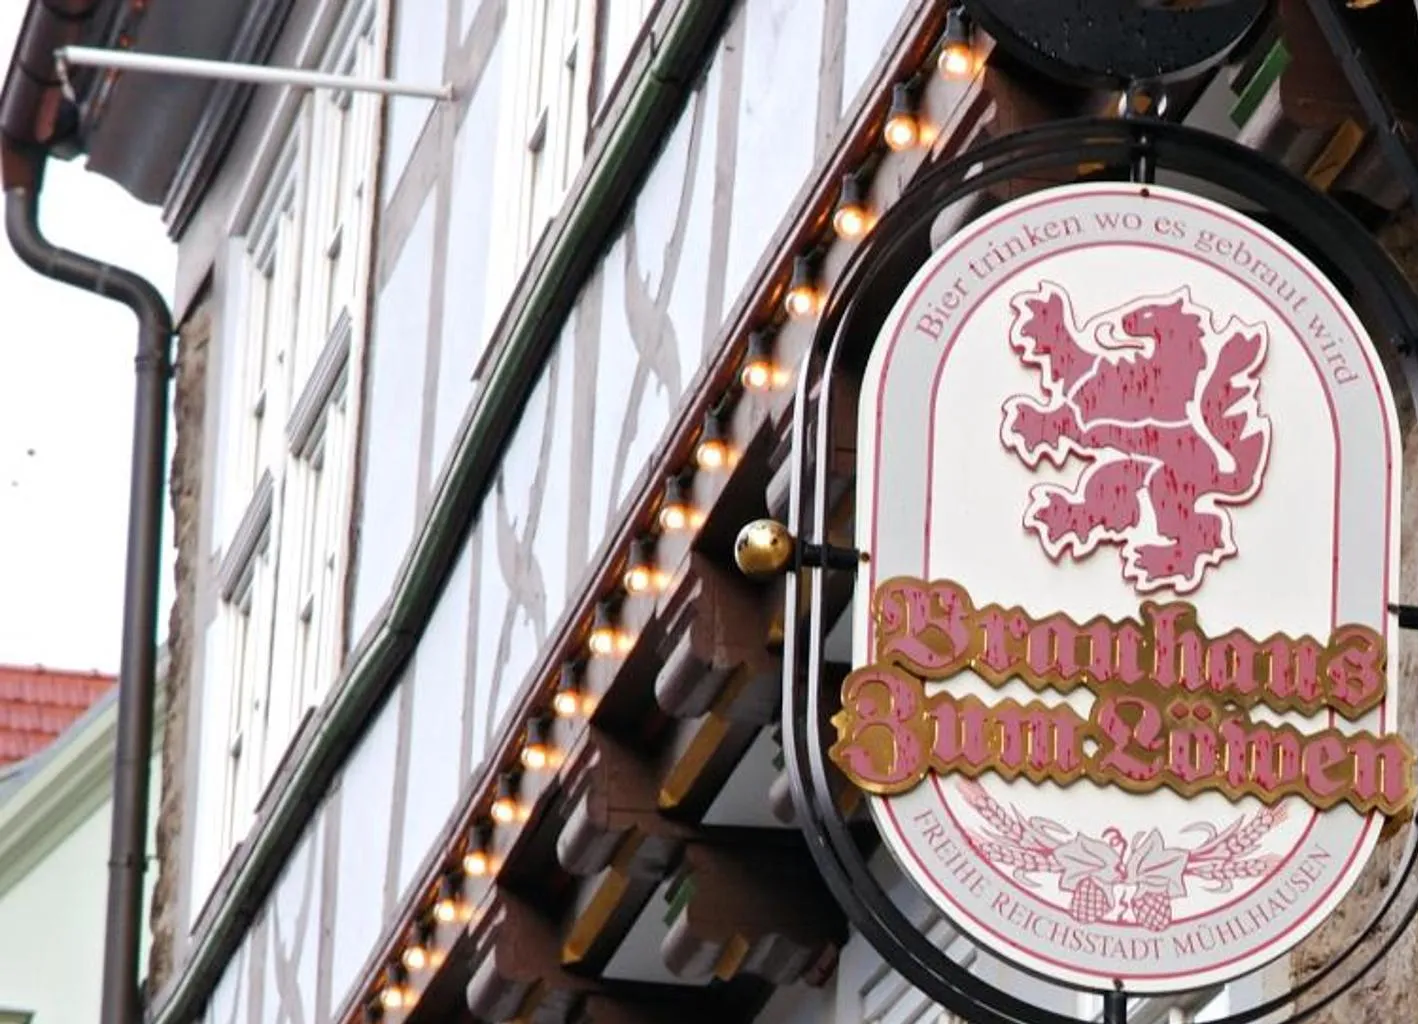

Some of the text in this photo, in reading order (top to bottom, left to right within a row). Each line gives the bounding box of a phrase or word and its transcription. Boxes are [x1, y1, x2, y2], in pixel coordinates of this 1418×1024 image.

[916, 212, 1359, 386] Bier trinken wo es gebraut wird
[874, 582, 1384, 706] Brauhaus
[840, 668, 1412, 805] Zum Löwen
[991, 890, 1165, 962] REICHSSTADT
[1173, 842, 1332, 958] MÜHLHAUSEN
